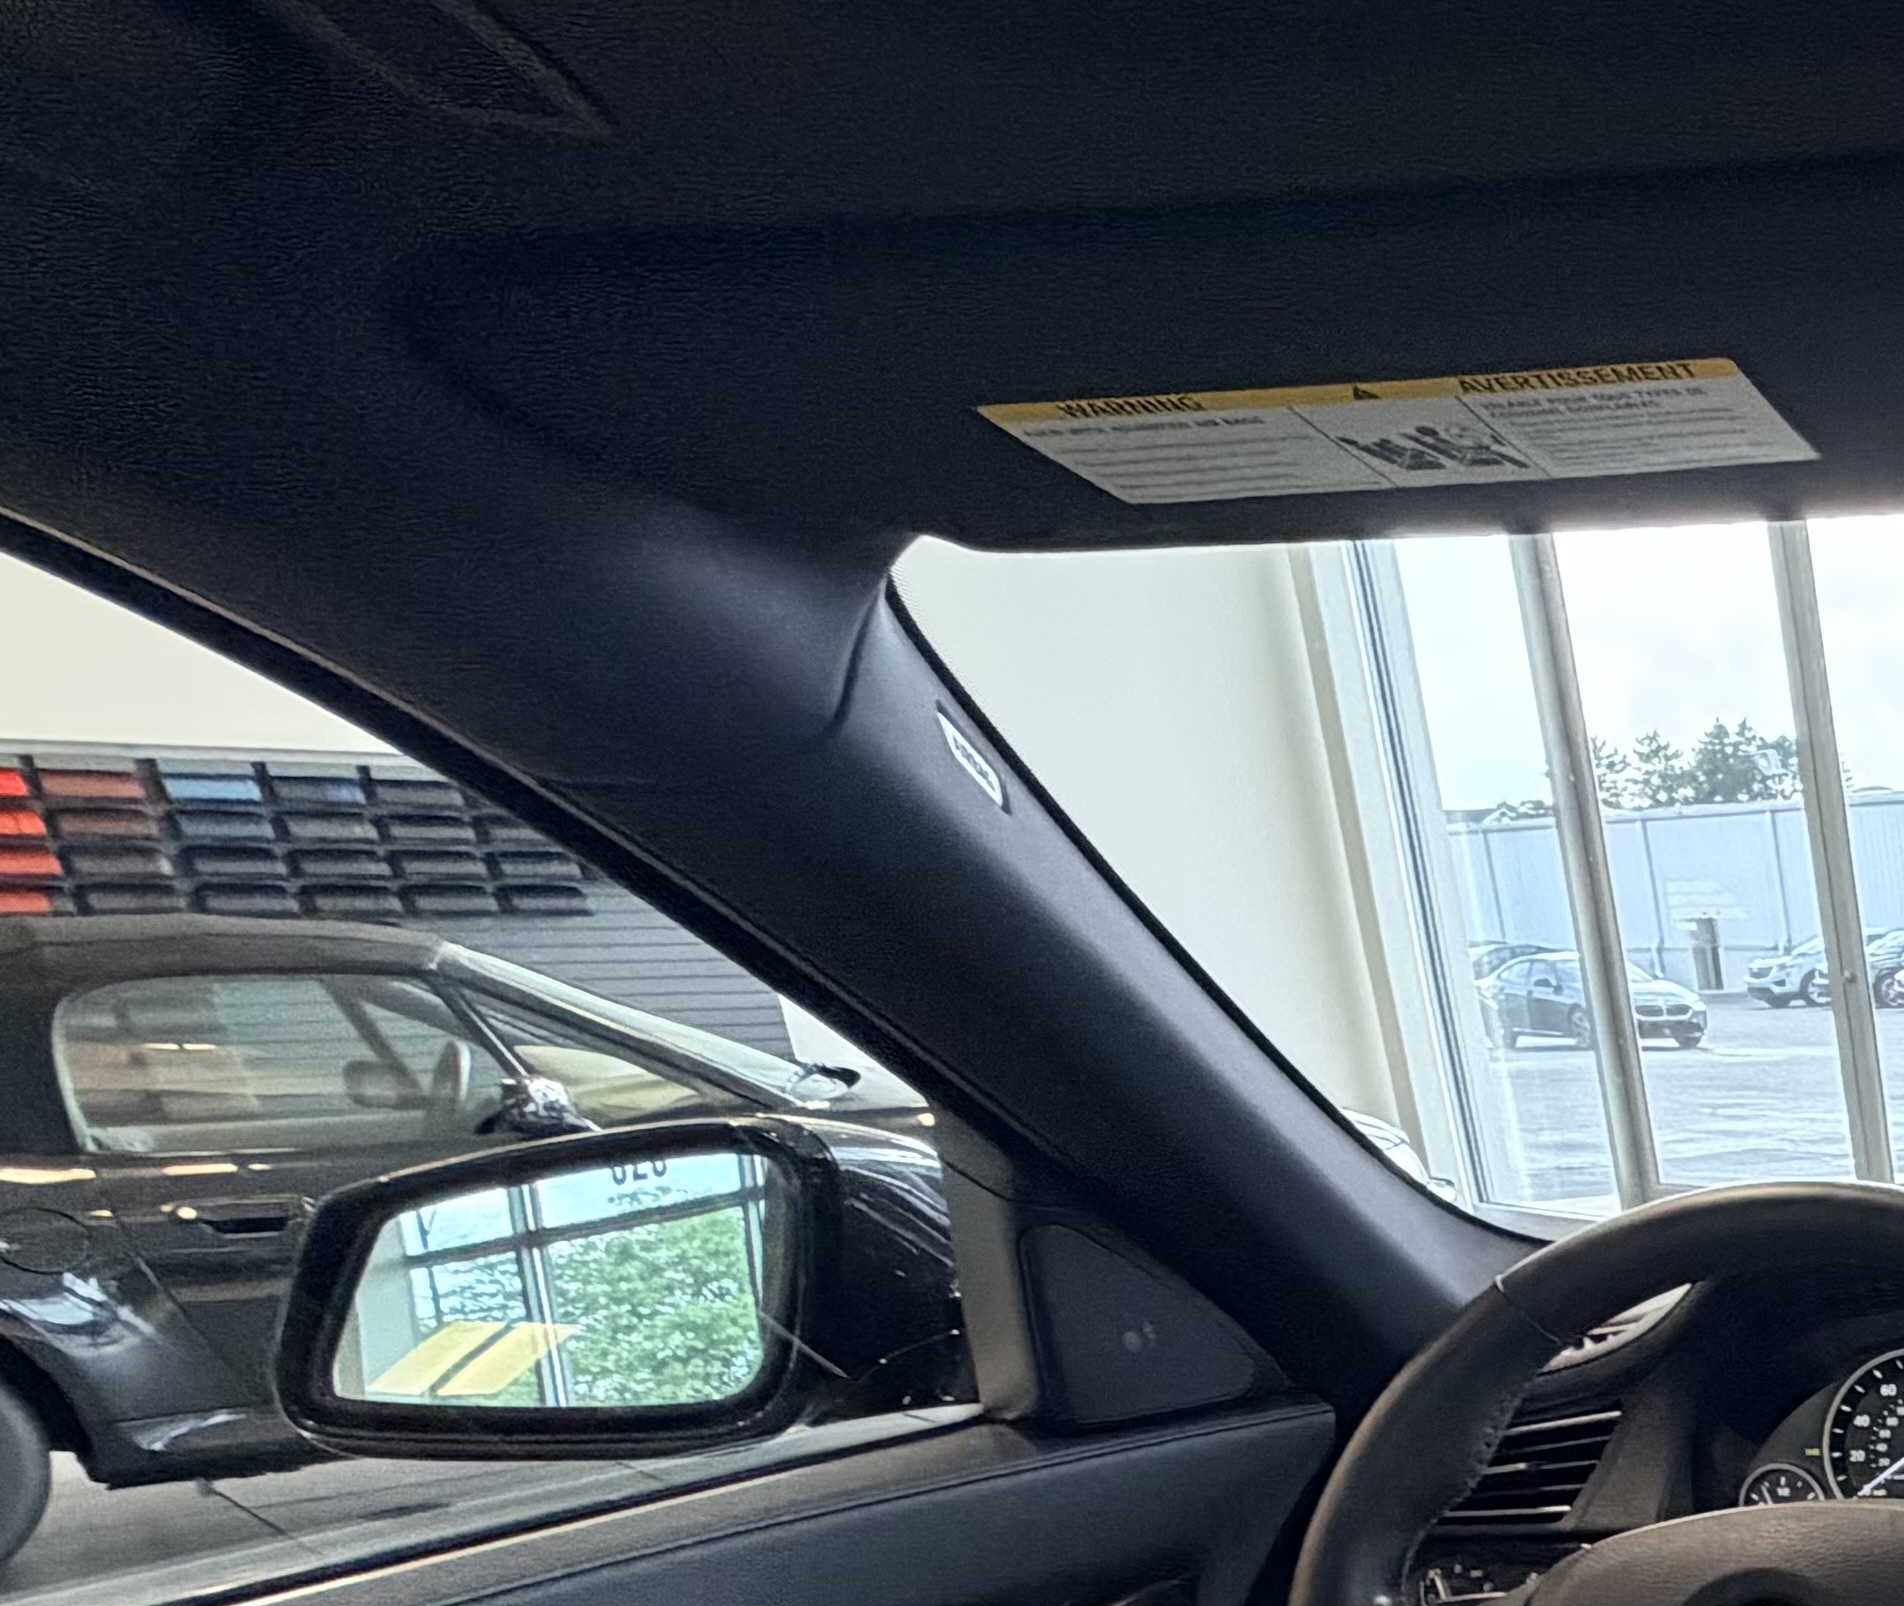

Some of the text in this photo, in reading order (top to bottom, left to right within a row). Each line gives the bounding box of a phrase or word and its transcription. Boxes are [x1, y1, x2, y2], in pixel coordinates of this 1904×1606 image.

[1457, 363, 1699, 395] AVERTISSEMENT
[1056, 395, 1205, 418] WARNING
[1880, 1384, 1897, 1396] 60
[1853, 1414, 1870, 1427] 40
[1849, 1450, 1866, 1462] 20
